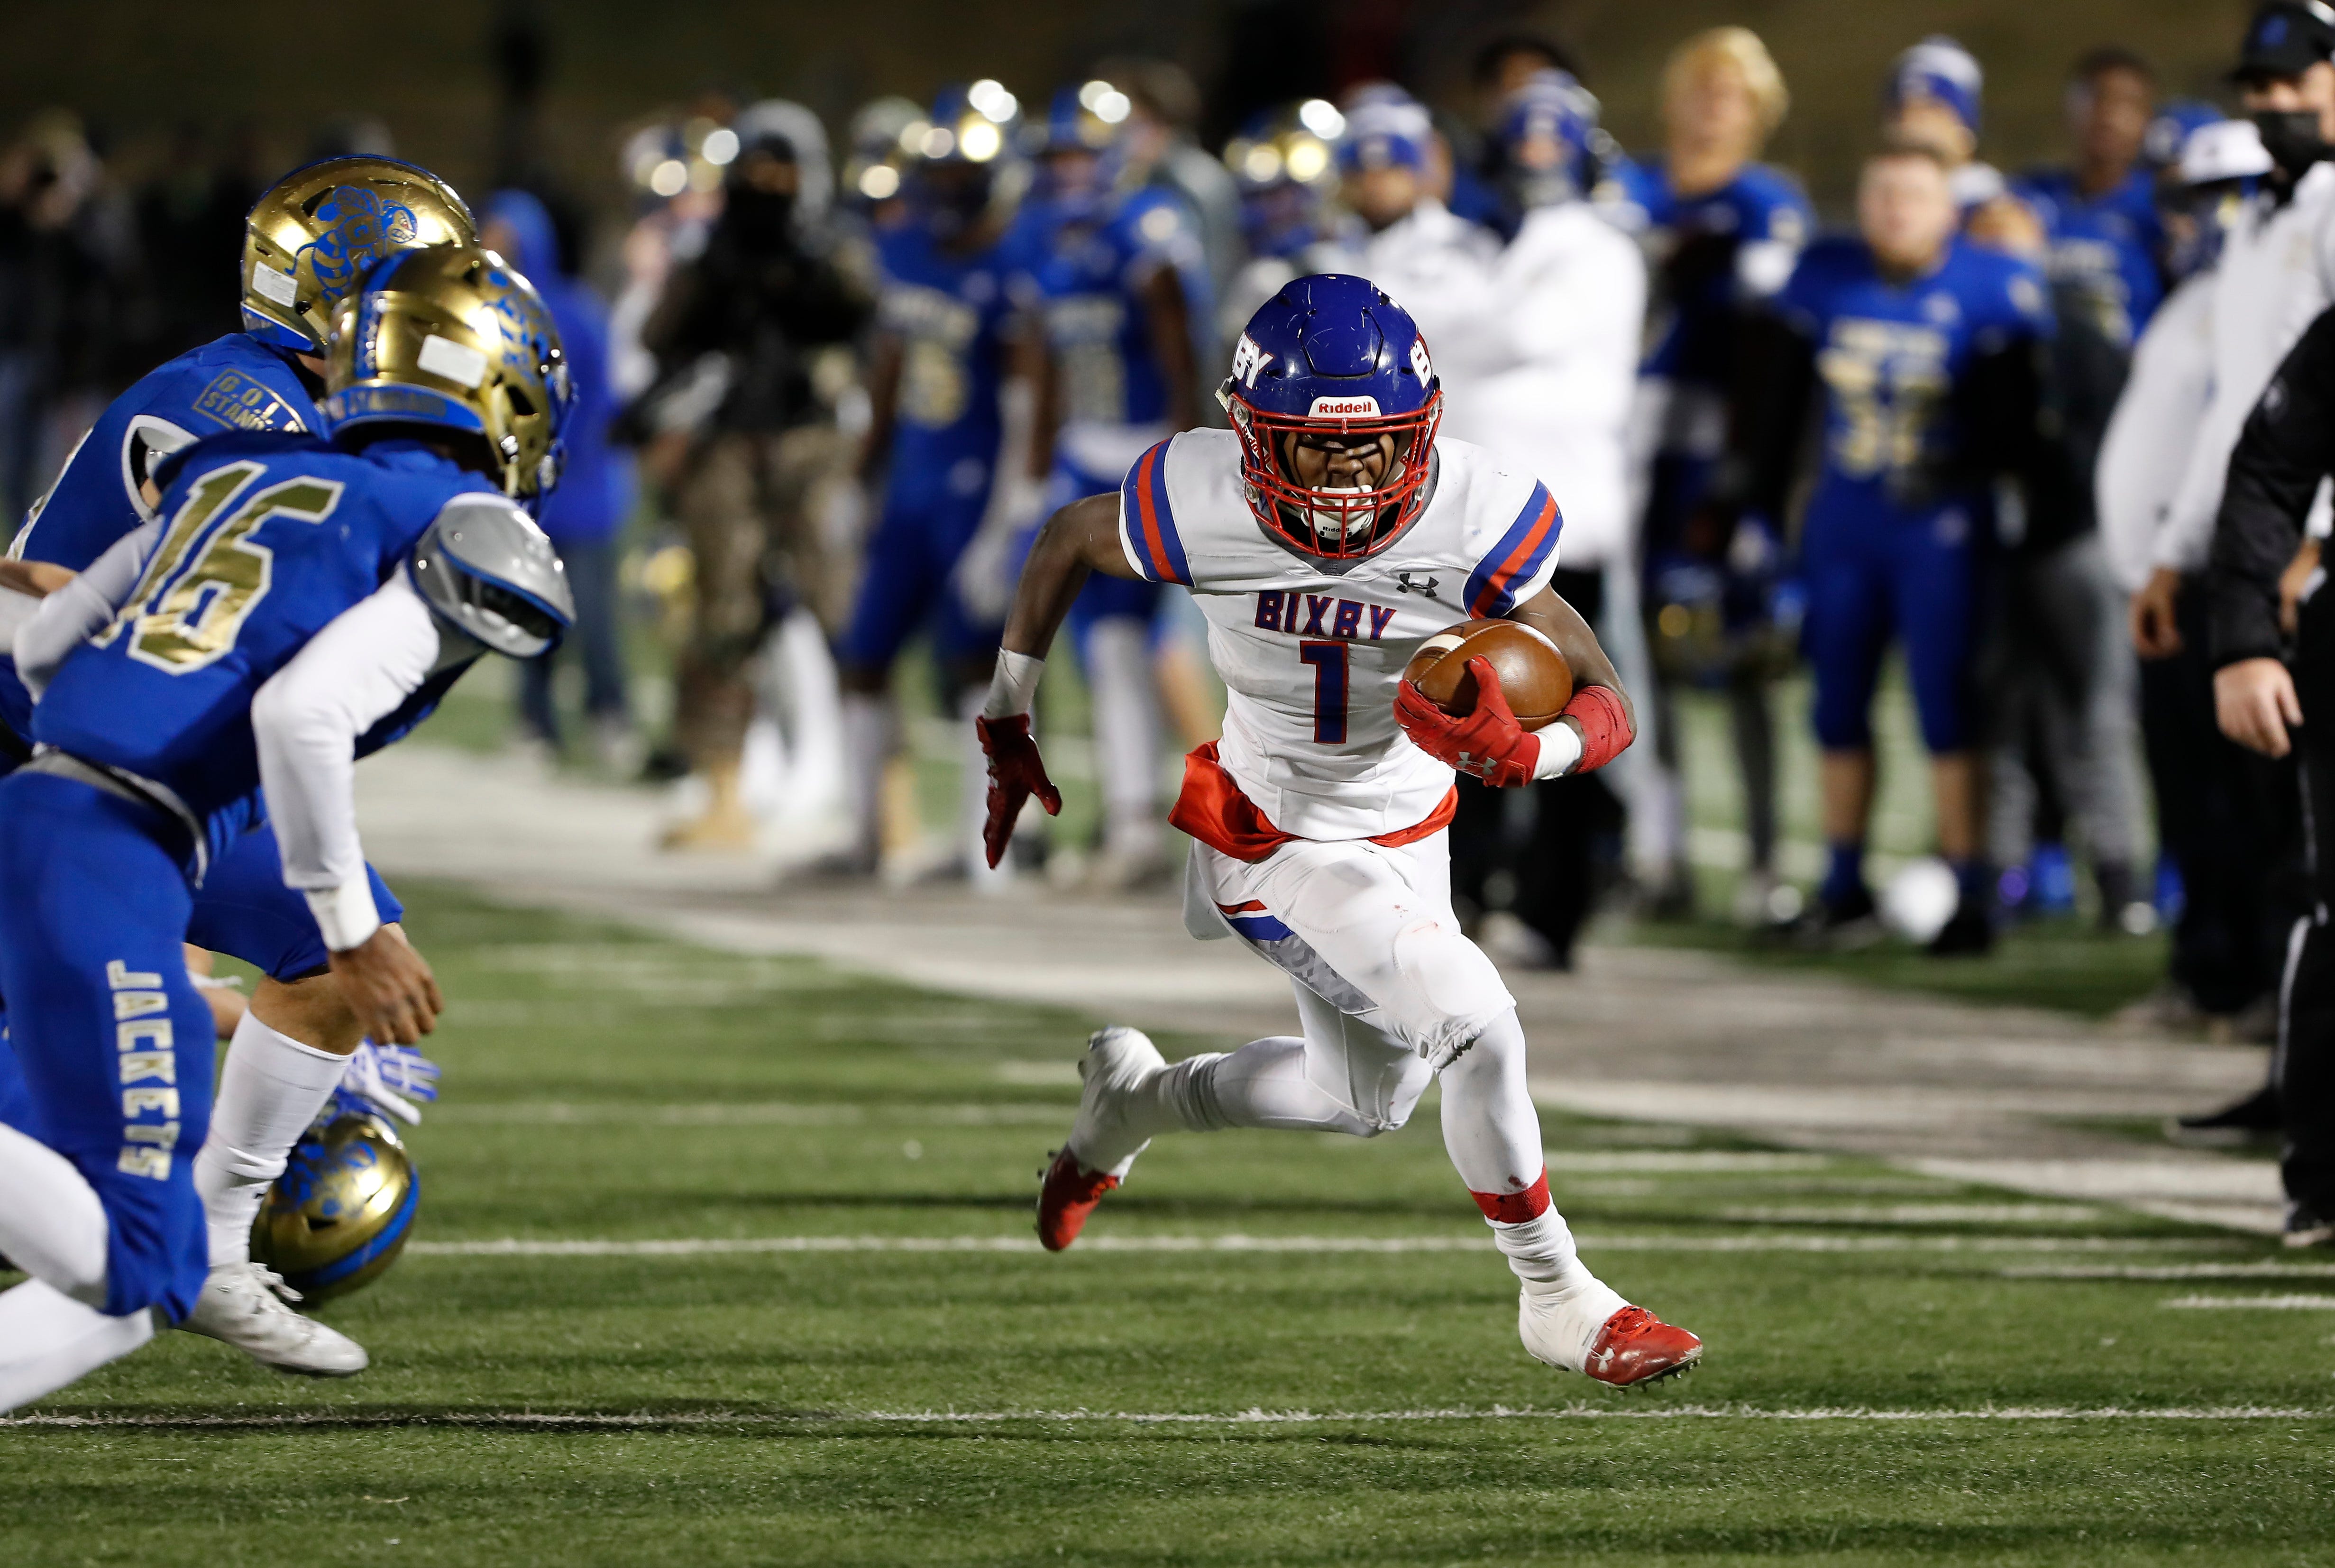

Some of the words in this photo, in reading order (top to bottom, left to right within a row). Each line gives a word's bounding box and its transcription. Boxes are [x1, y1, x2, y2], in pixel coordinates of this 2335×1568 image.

[1232, 330, 1275, 391] BY
[1319, 402, 1372, 413] Riddell
[90, 459, 345, 676] 16
[1254, 590, 1397, 640] BIXBY
[1299, 640, 1349, 744] 1
[106, 959, 181, 1182] JACKETS
